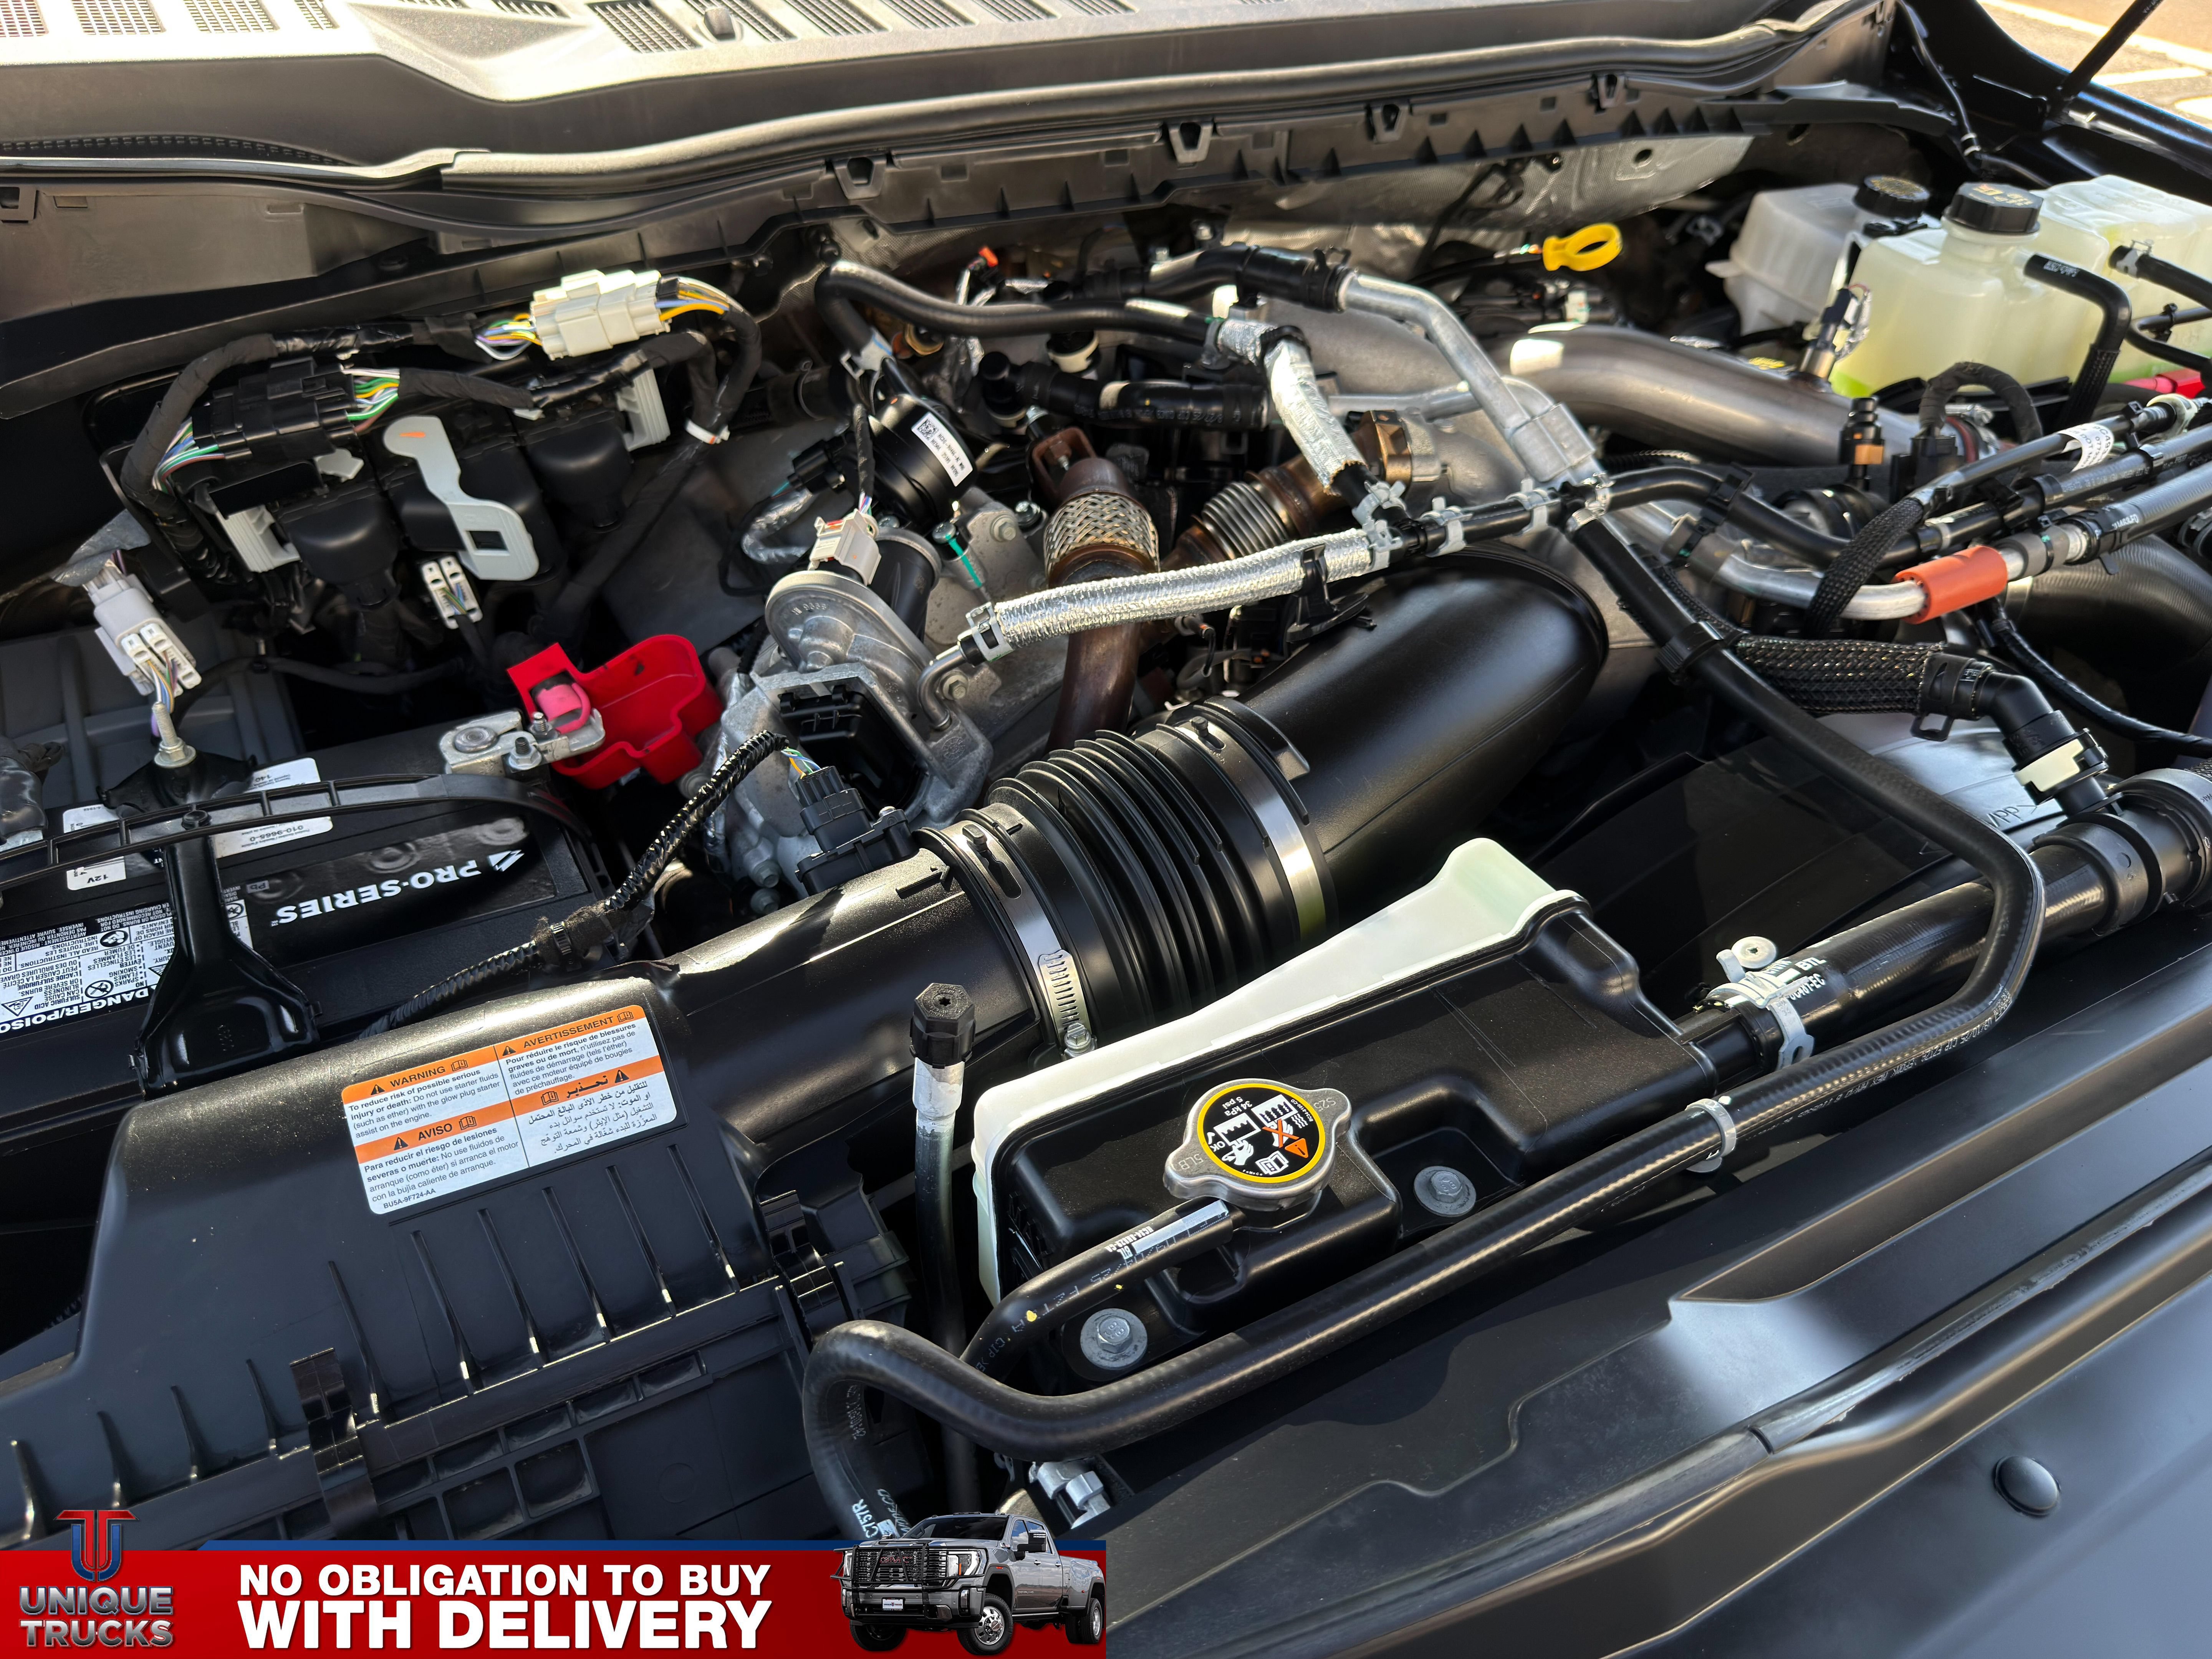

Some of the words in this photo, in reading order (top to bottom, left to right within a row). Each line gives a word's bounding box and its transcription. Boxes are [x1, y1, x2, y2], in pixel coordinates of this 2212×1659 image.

[85, 873, 109, 884] 12V
[248, 882, 267, 891] Pb
[58, 944, 82, 953] TOUTES
[104, 946, 125, 955] FUMER
[18, 953, 66, 968] INSTRUCTIONS.
[88, 957, 124, 970] ÉTINCELLES
[93, 952, 123, 964] FLAMMES
[119, 958, 141, 968] ÉVITER
[1796, 955, 1827, 972] BTL
[22, 965, 54, 977] BRÛLURES
[35, 970, 60, 980] CAUSER
[55, 971, 78, 981] L'ACIDE
[61, 965, 77, 974] PEUT
[109, 966, 137, 977] SMOKING
[114, 971, 137, 981] FLAMES
[3, 978, 24, 989] CÉCITÉ
[17, 977, 54, 990] SULFURIQUE
[44, 980, 68, 991] SEVERE
[114, 976, 138, 987] SPARKS
[18, 987, 42, 996] BURNS.
[44, 983, 79, 996] BLINDNESS
[44, 992, 65, 1002] CAUSE
[51, 994, 79, 1005] SULFURIC
[0, 988, 148, 1033] DANGER/POISO
[524, 1016, 613, 1048] AVERTISSEMENT
[506, 1056, 524, 1065] Pour
[526, 1048, 553, 1059] réduire
[563, 1038, 587, 1048] risque
[599, 1024, 636, 1037] blessures
[508, 1061, 534, 1073] graves
[559, 1048, 579, 1057] mort,
[612, 1034, 625, 1042] pas
[510, 1069, 534, 1079] fluides
[546, 1054, 584, 1068] démarrage
[586, 1049, 601, 1058] (tels
[513, 1078, 530, 1087] avec
[542, 1067, 567, 1078] moteur
[569, 1058, 593, 1070] équipé
[604, 1048, 632, 1059] bougies
[390, 1066, 445, 1087] WARNING
[361, 1097, 388, 1108] reduce
[390, 1091, 405, 1099] risk
[417, 1079, 450, 1093] possible
[452, 1070, 480, 1081] serious
[526, 1074, 575, 1093] préchauffage.
[351, 1110, 373, 1120] injury
[387, 1099, 411, 1109] death:
[455, 1079, 477, 1089] starter
[479, 1073, 498, 1082] fluids
[353, 1118, 374, 1130] (such
[387, 1108, 409, 1119] ether)
[410, 1103, 426, 1112] with
[441, 1094, 457, 1104] glow
[460, 1089, 475, 1099] plug
[477, 1081, 499, 1092] starter
[1220, 1097, 1237, 1110] psi
[1240, 1099, 1253, 1110] 34
[1290, 1094, 1314, 1126] BC34-8100-CD
[1223, 1105, 1242, 1118] kPa
[356, 1127, 377, 1138] assist
[404, 1113, 432, 1123] engine.
[419, 1123, 452, 1141] AVISO
[364, 1163, 383, 1172] Para
[385, 1153, 413, 1166] reducir
[425, 1142, 450, 1154] riesgo
[464, 1128, 497, 1142] lesiones
[1208, 1139, 1226, 1152] OK
[367, 1169, 399, 1182] severas
[408, 1156, 439, 1169] muerte:
[469, 1139, 493, 1151] fluidos
[369, 1177, 404, 1192] arranque
[406, 1169, 429, 1182] (como
[431, 1162, 449, 1172] éter)
[459, 1152, 487, 1164] arranca
[497, 1141, 518, 1152] motor
[1242, 1168, 1263, 1177] FoMoCo
[372, 1193, 386, 1202] con
[418, 1175, 447, 1187] caliente
[460, 1160, 495, 1174] arranque.
[383, 1188, 436, 1208] BU5A-9F724-AA
[1116, 1244, 1133, 1261] BTL
